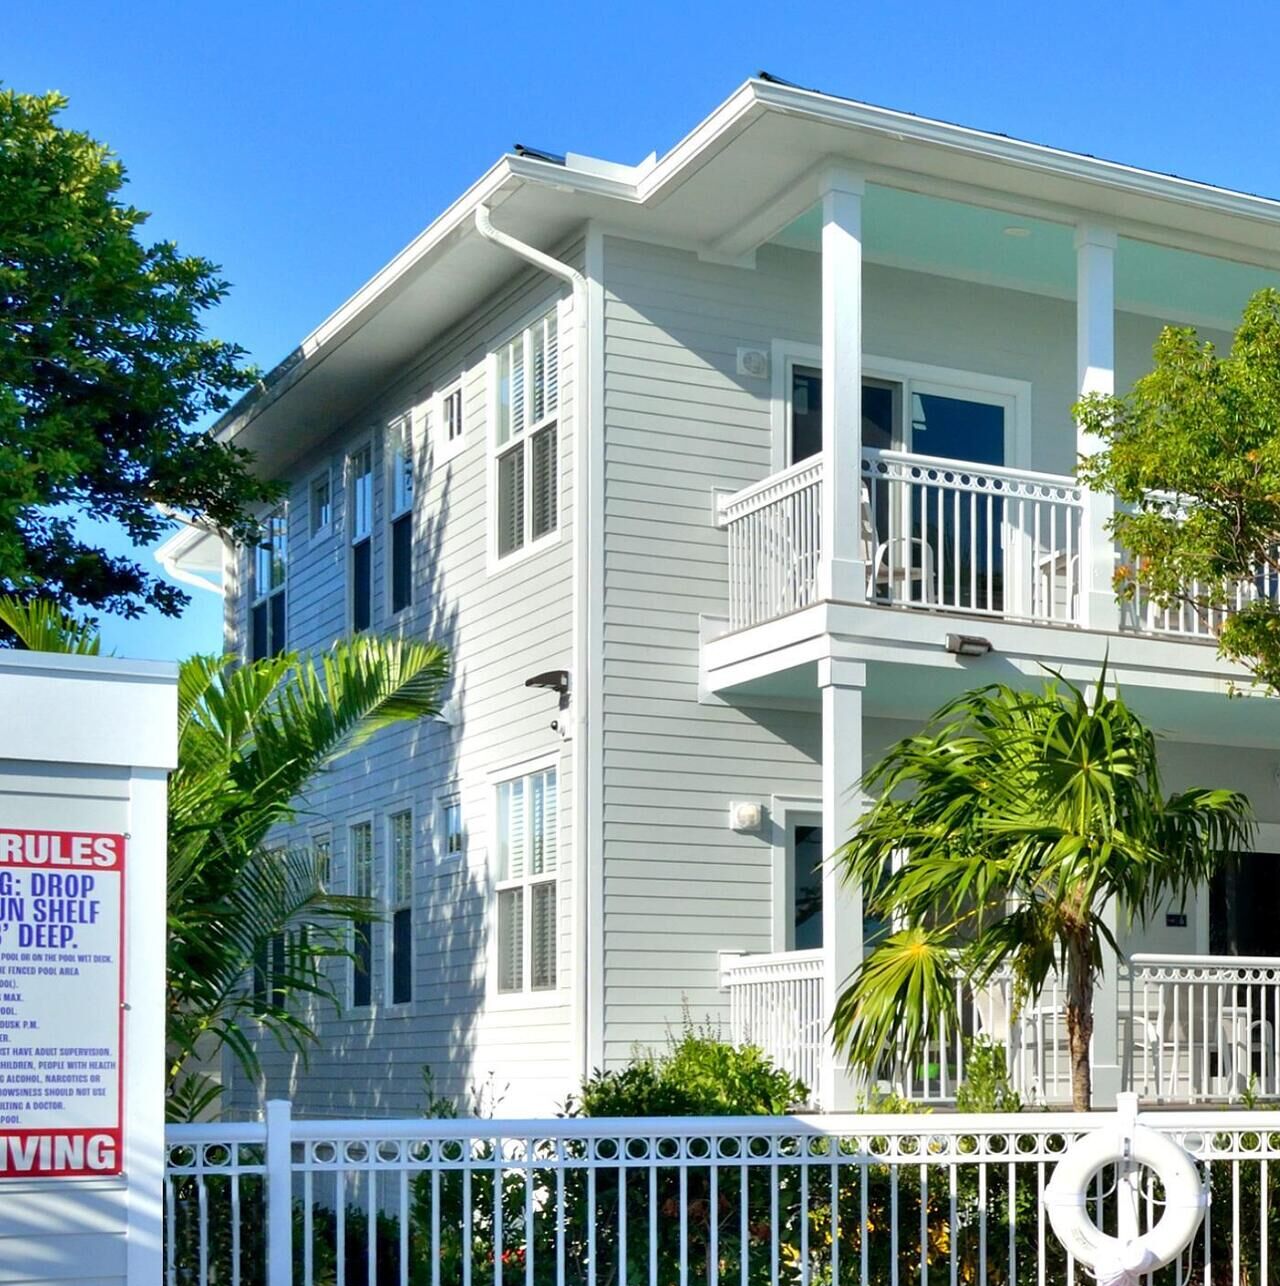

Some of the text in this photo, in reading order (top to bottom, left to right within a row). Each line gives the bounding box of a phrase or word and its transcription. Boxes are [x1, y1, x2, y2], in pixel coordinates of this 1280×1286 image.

[0, 833, 117, 867] RULES
[31, 872, 95, 898] DROP
[33, 898, 100, 924] SHELF
[18, 923, 78, 949] DEEP.
[1, 953, 18, 961] POOL
[58, 954, 76, 962] POOL
[8, 966, 36, 975] FENCED
[38, 967, 57, 976] POOL
[59, 967, 80, 976] AREA
[12, 1047, 33, 1056] HAVE
[35, 1047, 57, 1056] ADULT
[38, 1061, 65, 1070] PEOPLE
[67, 1061, 87, 1070] WITH
[89, 1061, 116, 1070] HEALTH
[45, 1074, 89, 1083] NARCOTICS
[90, 1074, 101, 1083] OR
[44, 1088, 74, 1097] SHOULD
[75, 1088, 90, 1097] NOT
[92, 1088, 107, 1097] USE
[25, 1102, 32, 1110] A
[33, 1102, 66, 1111] DOCTOR.
